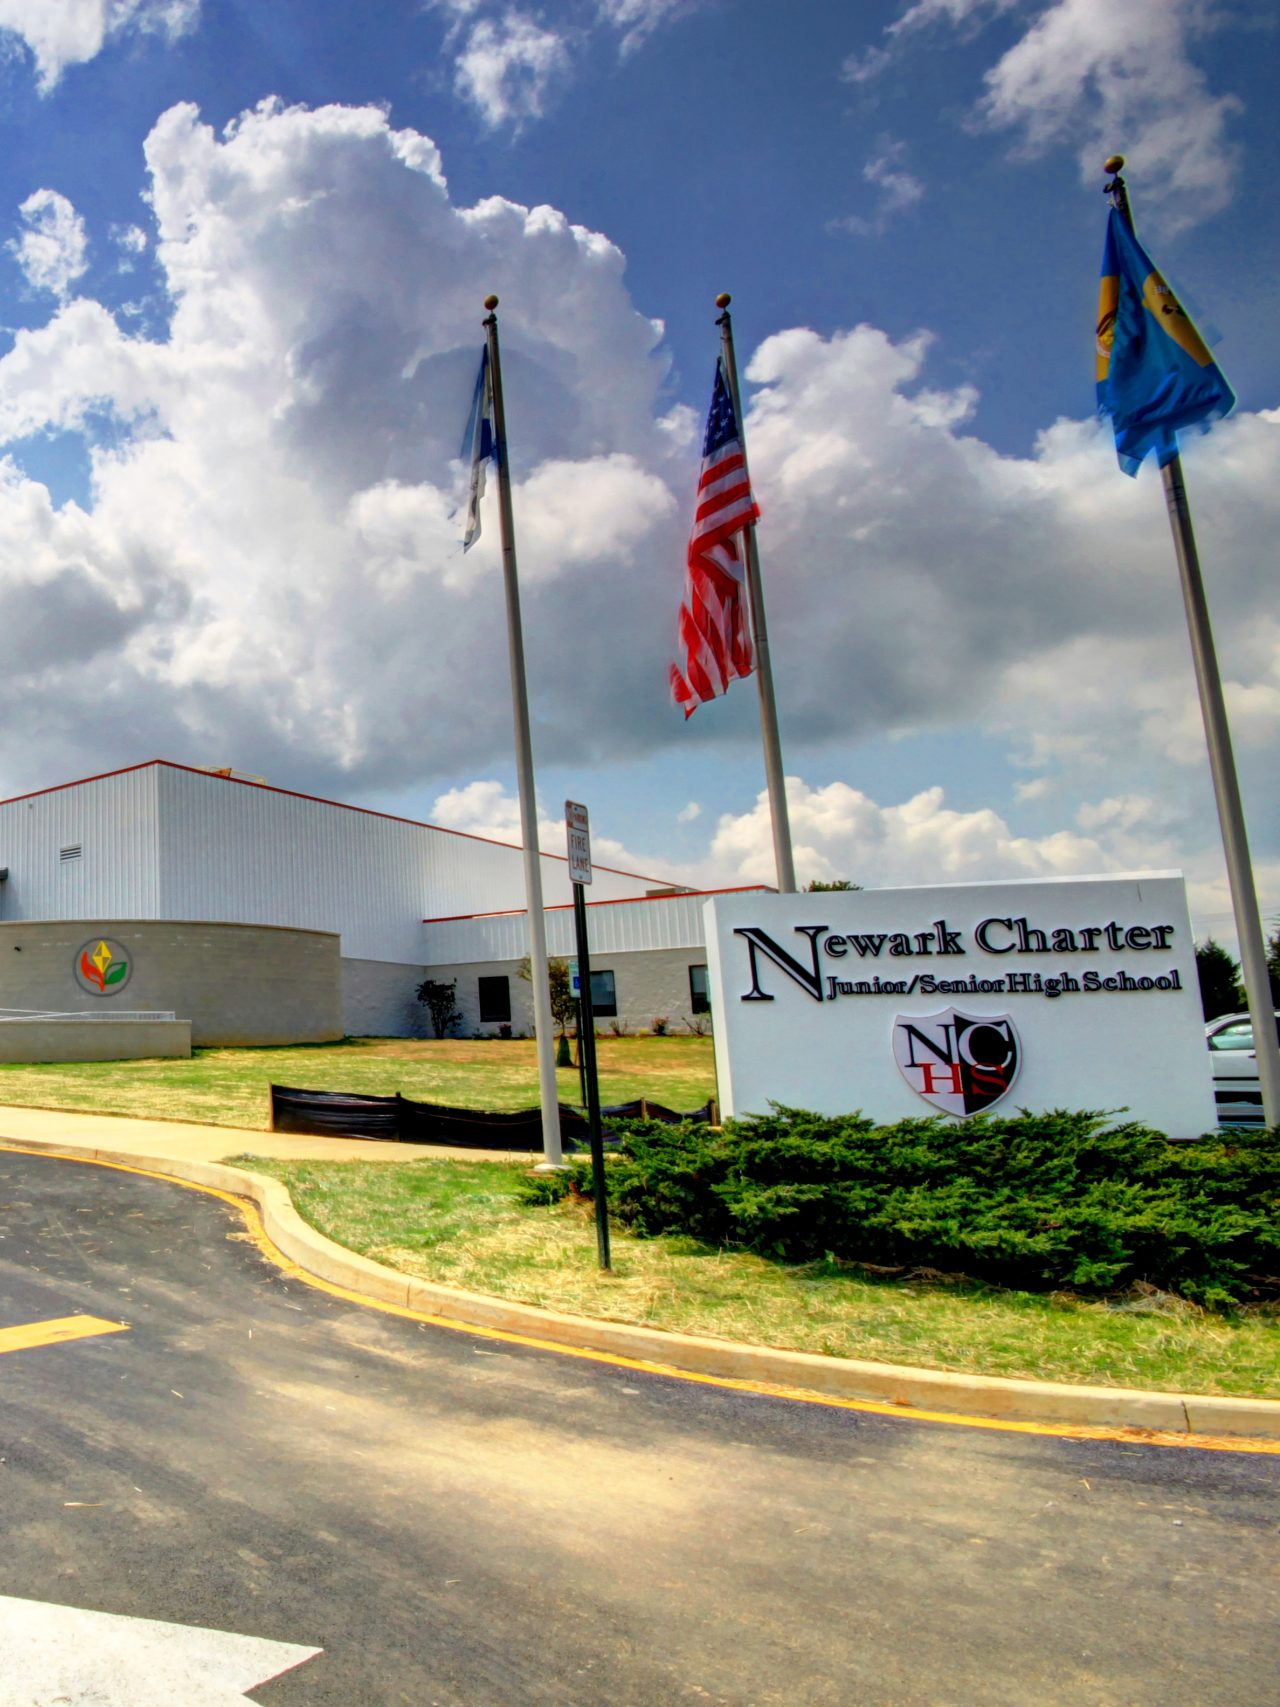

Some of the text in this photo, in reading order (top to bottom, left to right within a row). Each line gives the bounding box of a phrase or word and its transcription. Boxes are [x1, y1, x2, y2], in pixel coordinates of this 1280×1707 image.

[570, 834, 586, 853] FIRE
[572, 855, 589, 873] LANE
[733, 917, 1174, 1002] Newark Charter
[826, 969, 1183, 1000] Junior/Senior High School
